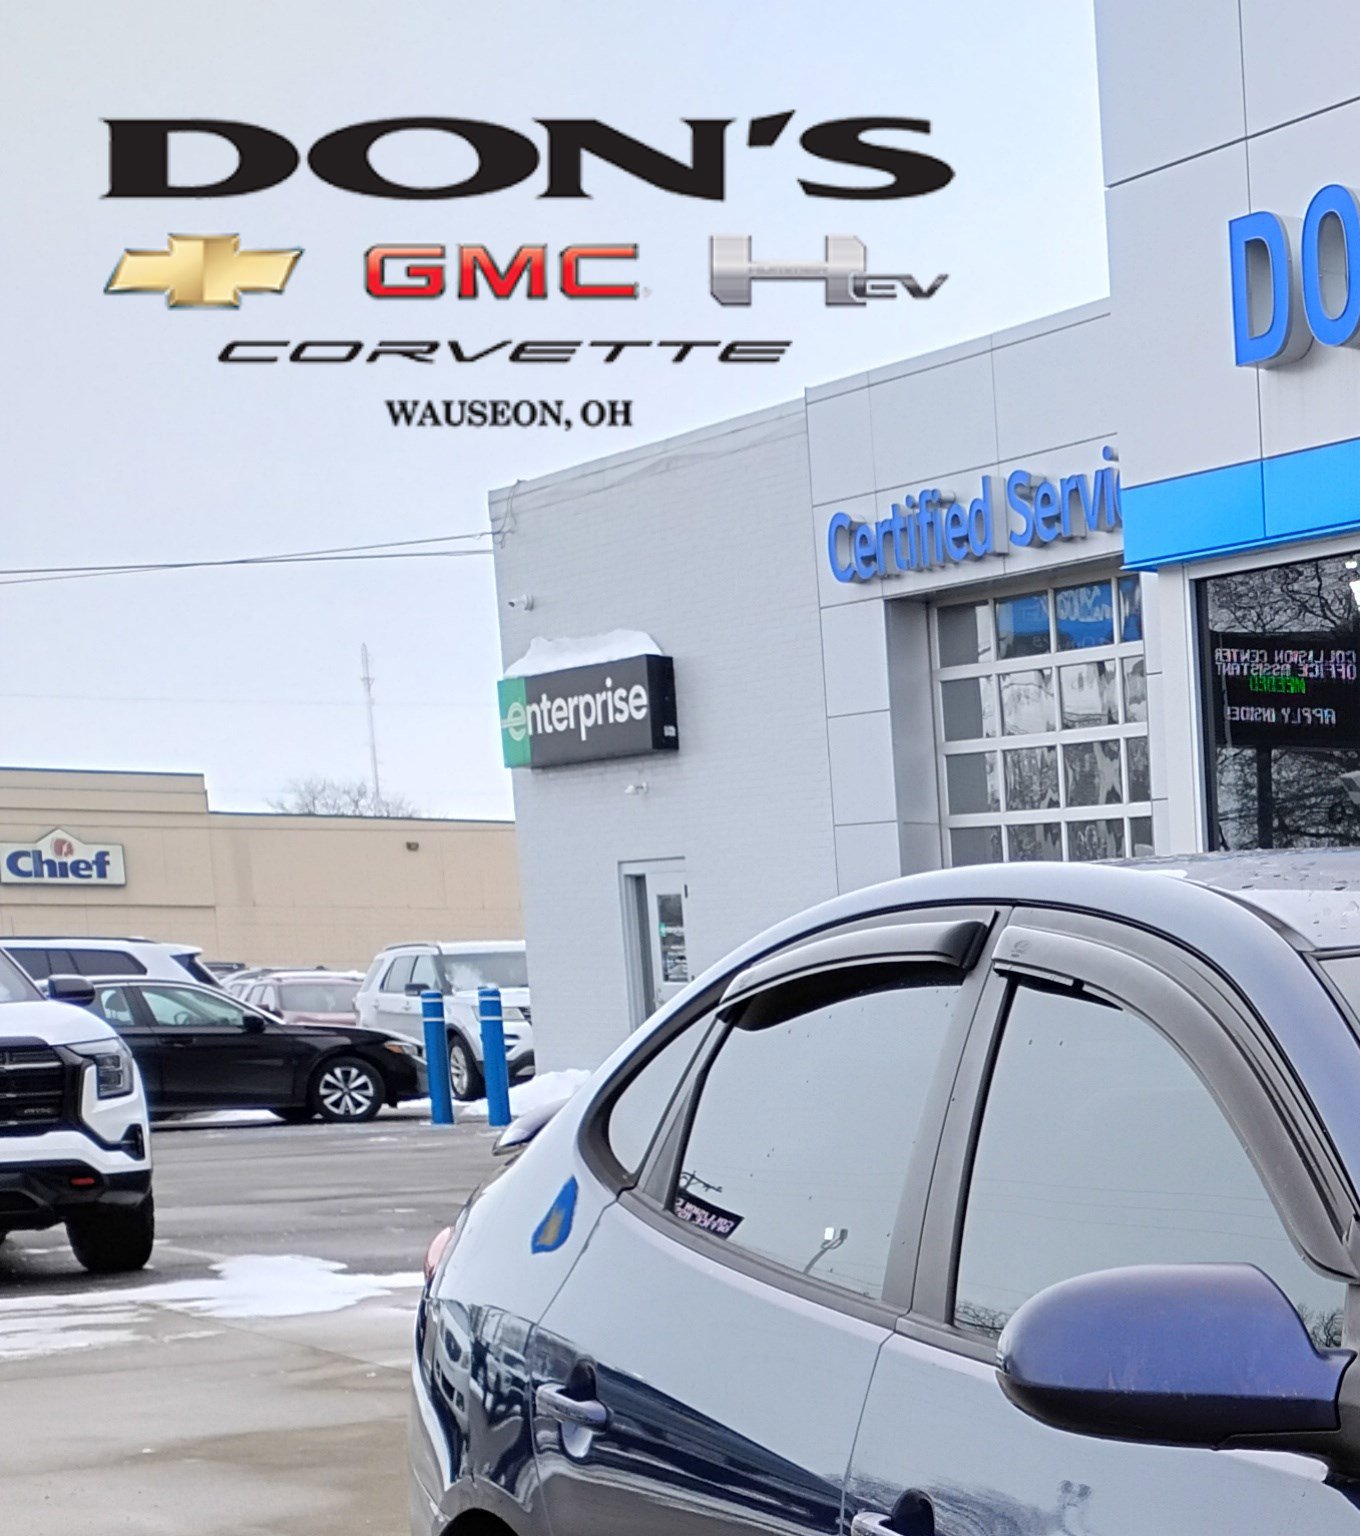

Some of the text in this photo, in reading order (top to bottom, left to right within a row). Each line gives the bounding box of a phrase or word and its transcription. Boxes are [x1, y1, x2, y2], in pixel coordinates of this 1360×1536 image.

[828, 445, 1124, 583] Certified Servi
[500, 676, 649, 742] enterprise
[6, 846, 111, 879] Chief
